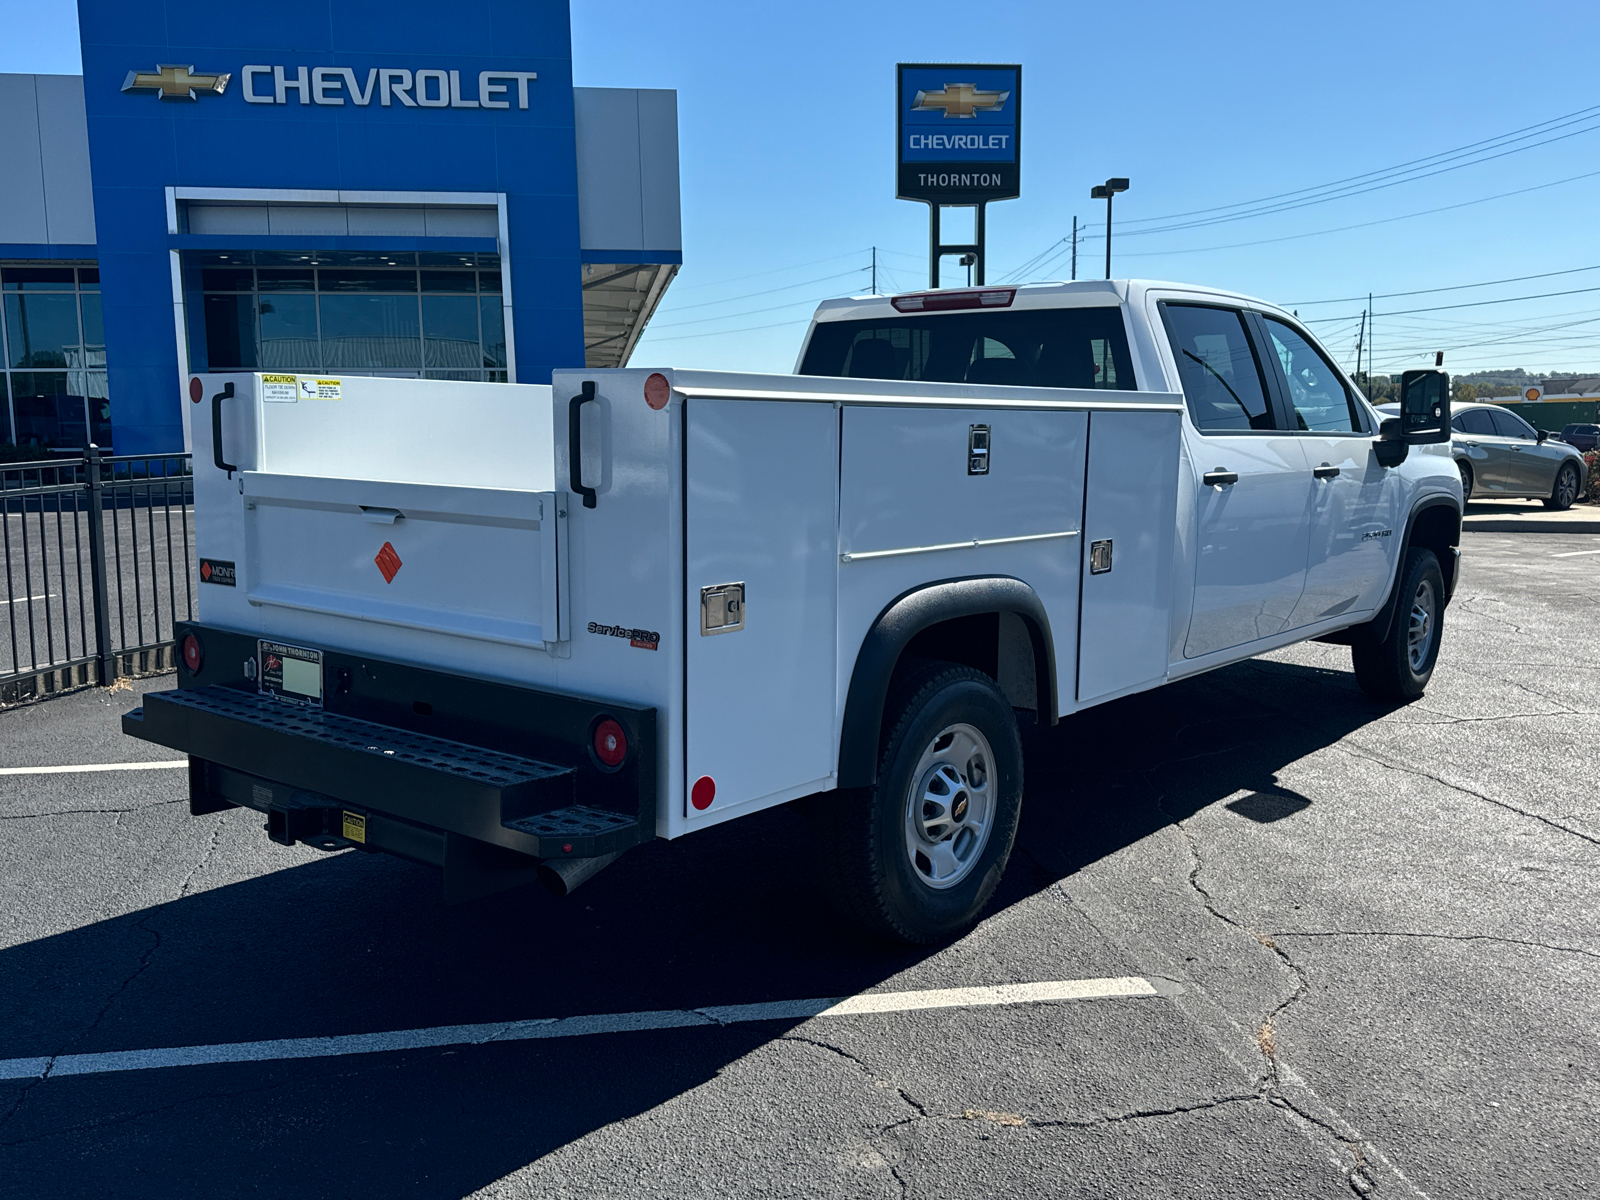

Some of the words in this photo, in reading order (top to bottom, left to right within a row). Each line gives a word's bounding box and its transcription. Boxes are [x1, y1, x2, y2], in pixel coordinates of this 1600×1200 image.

[241, 64, 538, 109] CHEVROLET
[909, 134, 1009, 149] CHEVROLET
[918, 173, 1001, 187] THORNTON
[269, 375, 296, 383] CAUTION
[344, 815, 364, 828] CAUTION
